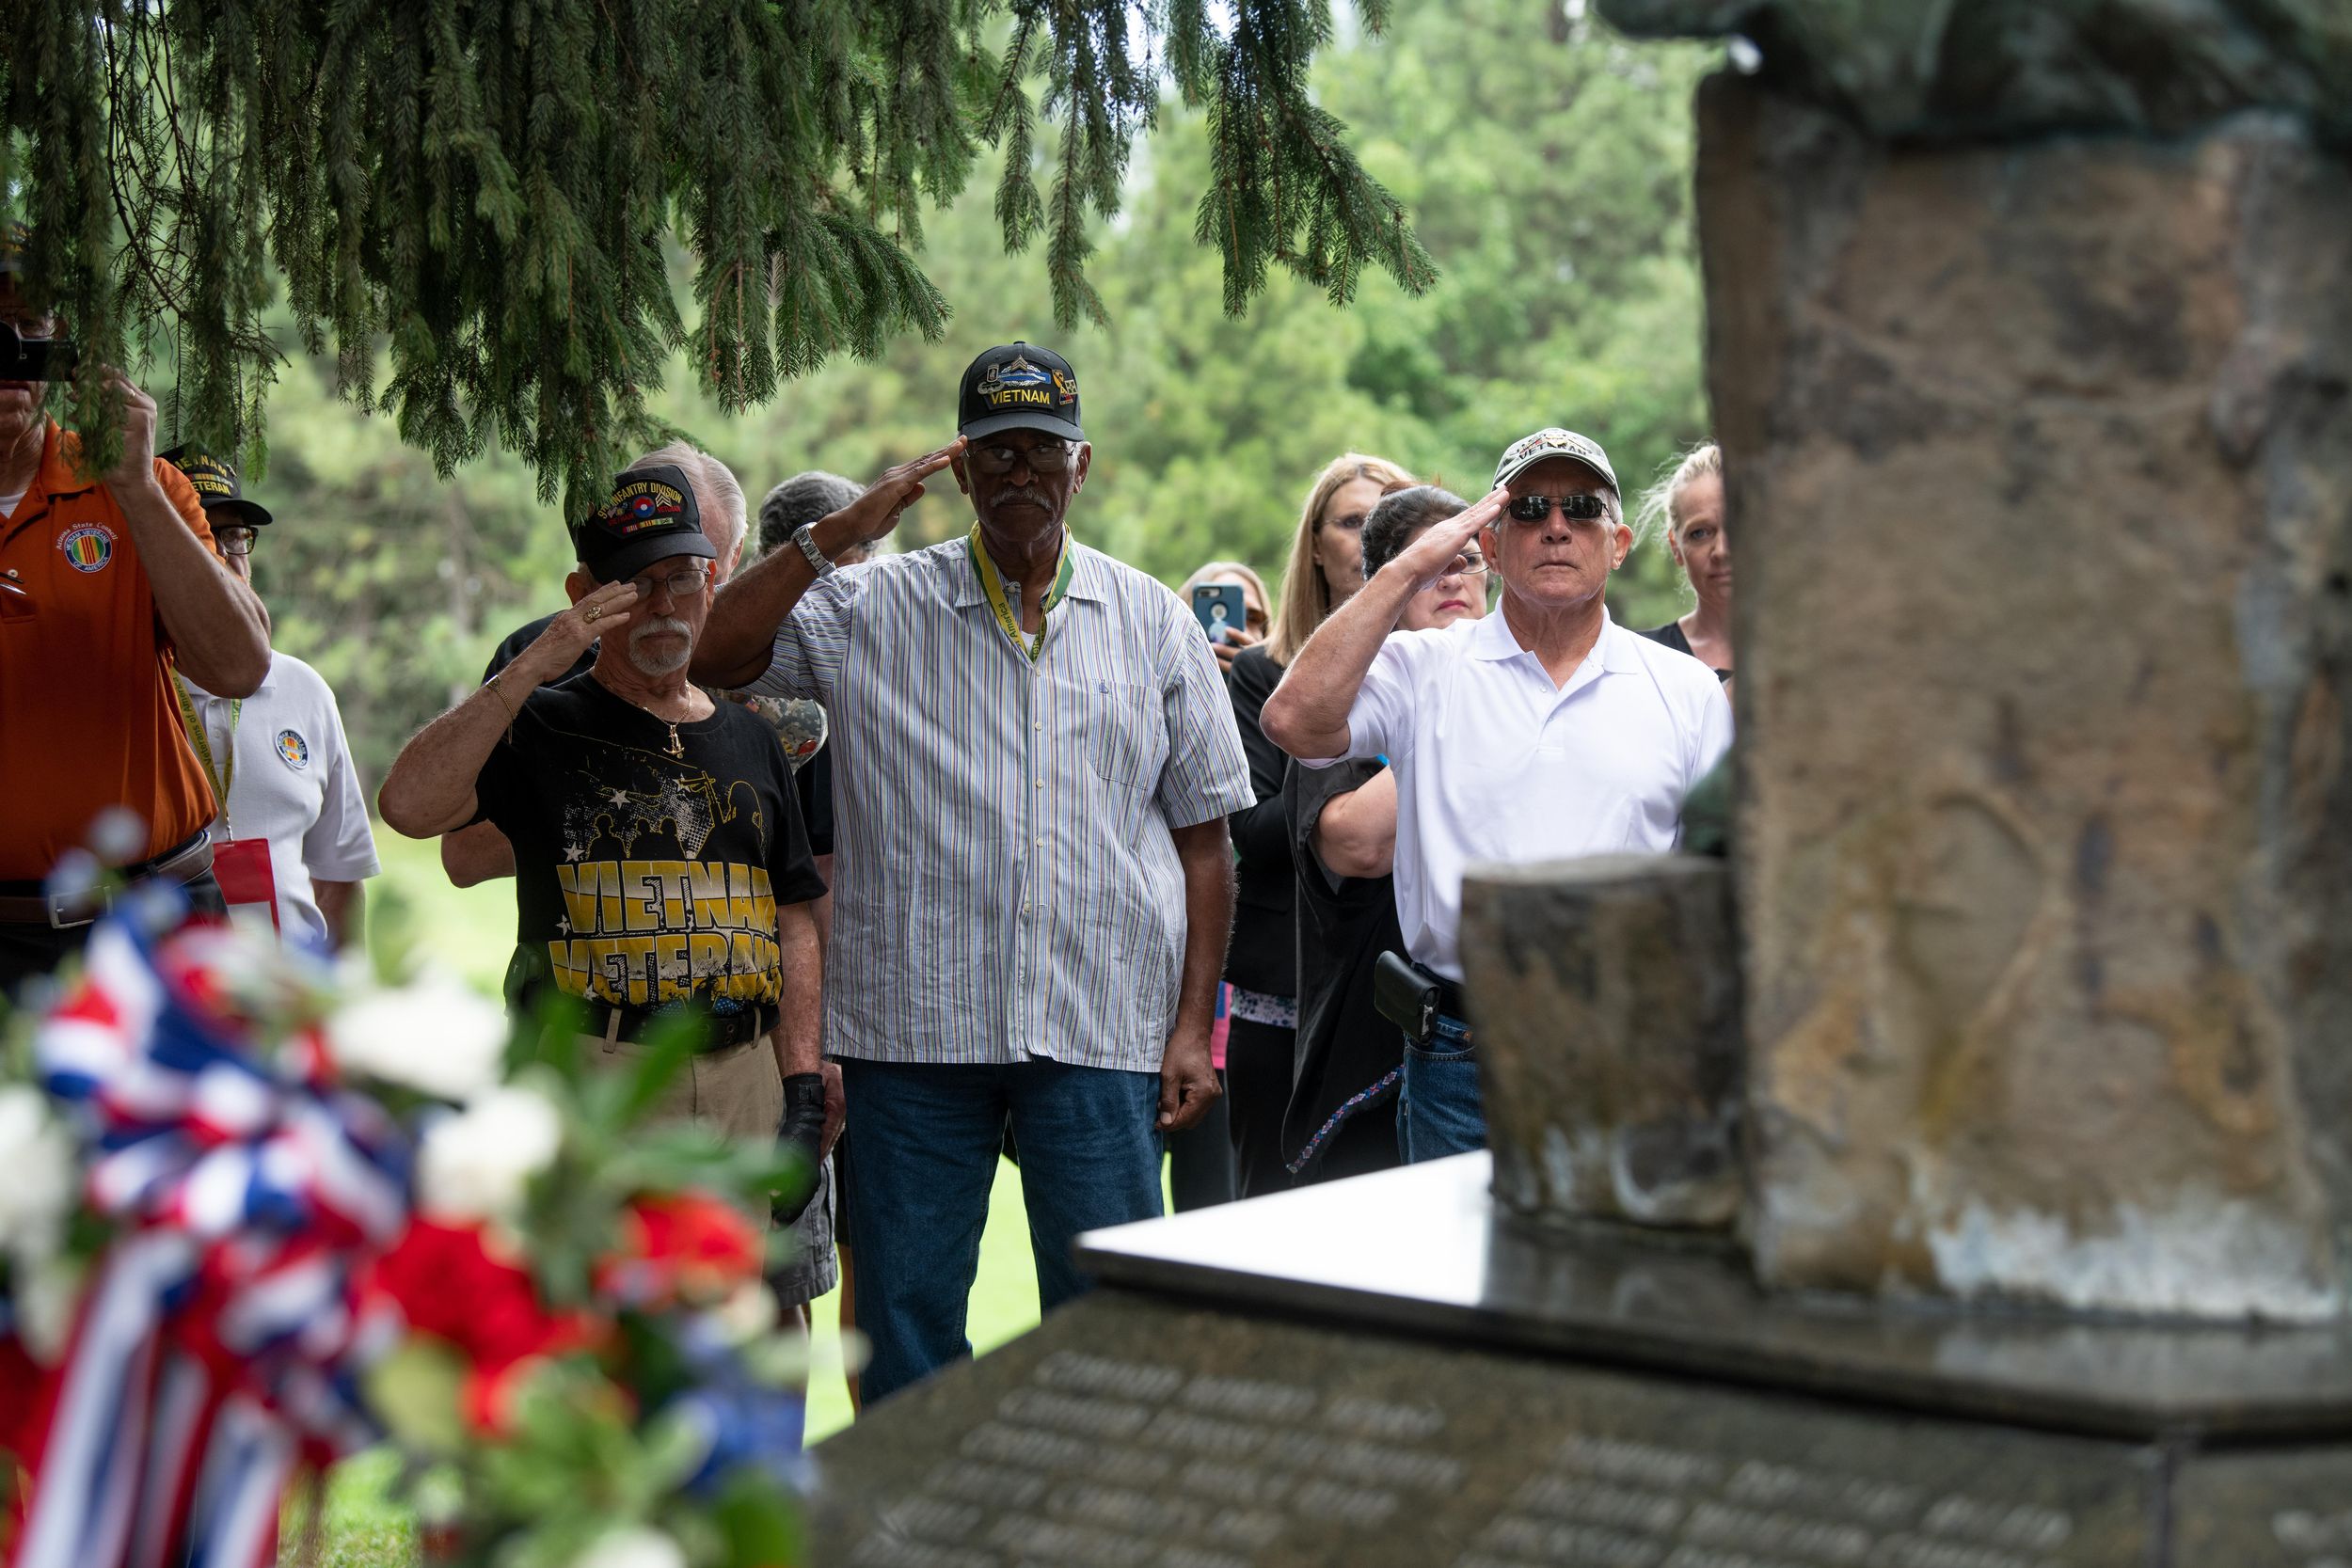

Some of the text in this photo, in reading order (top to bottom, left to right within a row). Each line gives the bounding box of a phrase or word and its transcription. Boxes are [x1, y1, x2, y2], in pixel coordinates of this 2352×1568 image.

[991, 389, 1050, 405] VIETNAM
[192, 481, 231, 495] ETERAN
[610, 482, 647, 506] INFANTRY
[650, 483, 683, 504] DIVISION
[56, 522, 119, 550] Arizona State Council
[66, 530, 110, 551] VIETNAM VETERANS
[84, 557, 109, 571] AMERICA
[998, 603, 1018, 638] America
[173, 676, 212, 765] Veterans of America
